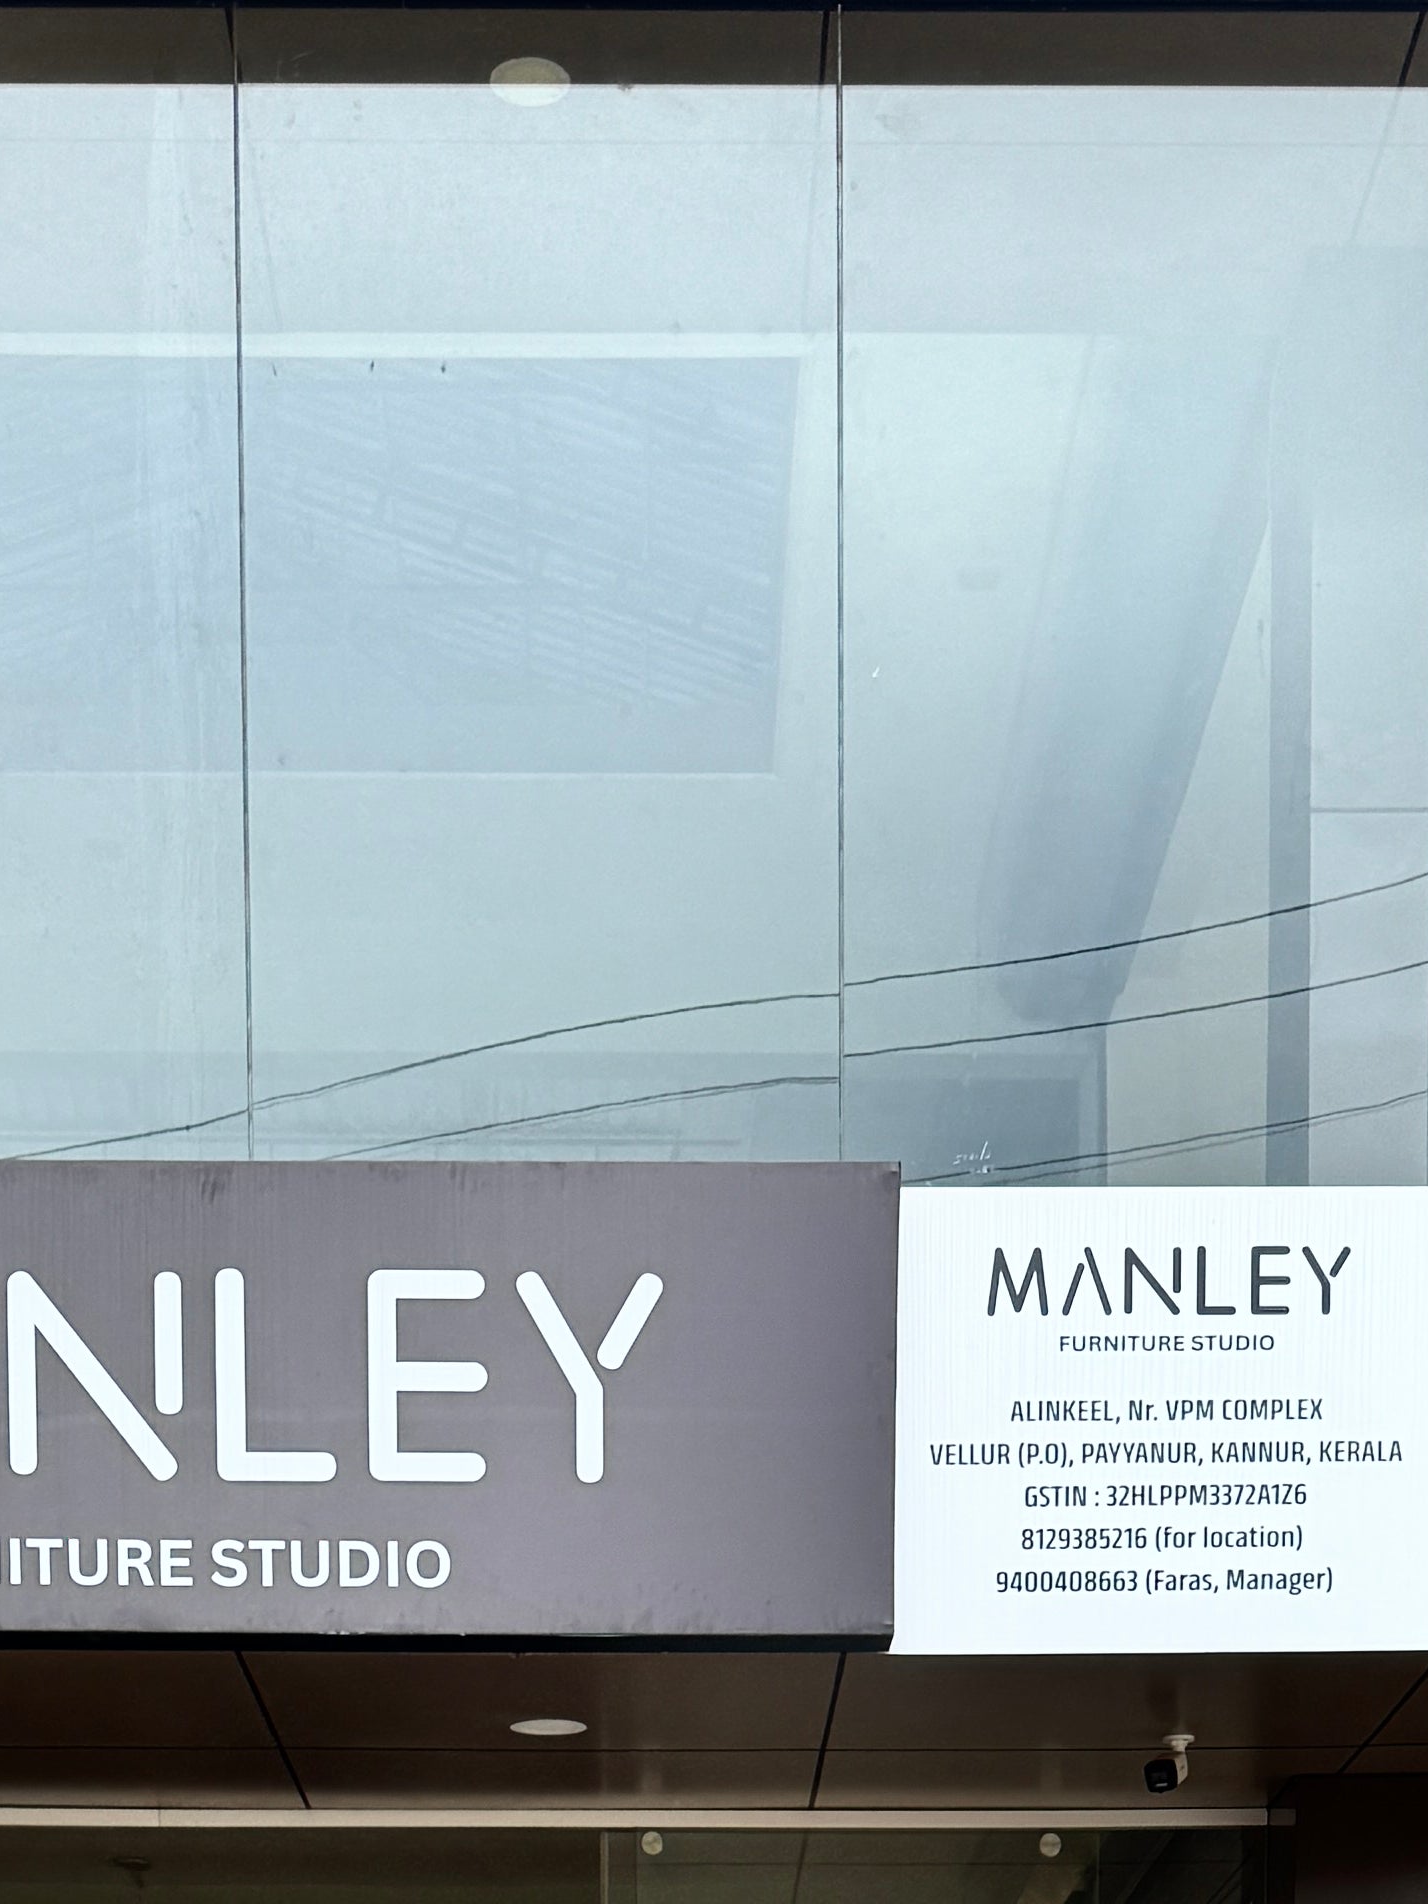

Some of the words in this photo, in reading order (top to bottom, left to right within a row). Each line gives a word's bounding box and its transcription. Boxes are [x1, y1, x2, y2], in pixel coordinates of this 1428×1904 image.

[986, 1245, 1352, 1317] MANLEY
[1059, 1335, 1185, 1352] FURNITURE
[1191, 1334, 1275, 1352] STUDIO
[1010, 1399, 1121, 1425] ALINKEEL,
[1128, 1399, 1158, 1422] Nr.
[1165, 1399, 1214, 1421] VPM
[1222, 1398, 1323, 1421] COMPLEX
[929, 1443, 1010, 1466] VELLUR
[1018, 1441, 1074, 1469] (P.O),
[1081, 1441, 1204, 1467] PAYYANUR,
[1211, 1440, 1312, 1466] KANNUR,
[1319, 1440, 1403, 1463] KERALA
[1024, 1485, 1087, 1508] GSTIN
[1106, 1483, 1307, 1507] 32HLPPM3372A1Z6
[1021, 1527, 1147, 1551] 8129385216
[1155, 1526, 1197, 1553] (for
[1203, 1524, 1303, 1552] location)
[210, 1538, 451, 1589] STUDIO
[996, 1570, 1138, 1593] 9400408663
[1145, 1568, 1219, 1595] (Faras,
[1226, 1566, 1333, 1596] Manager)
